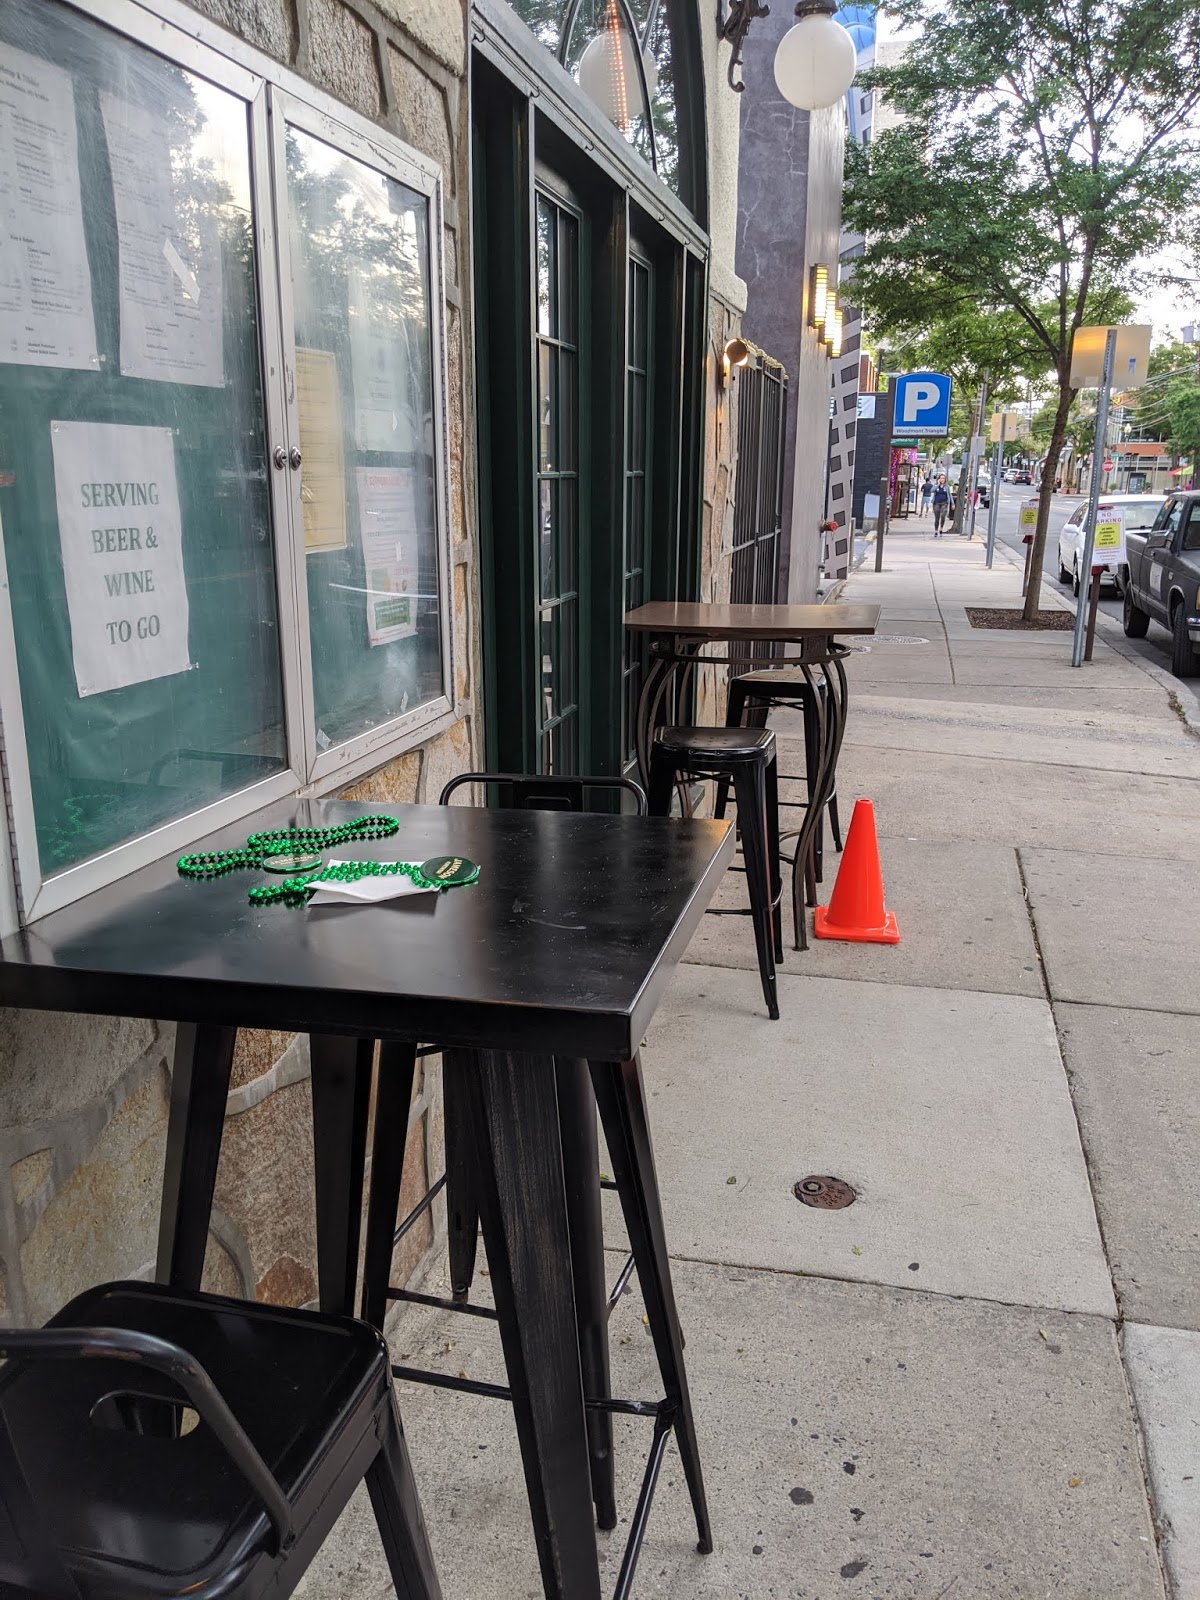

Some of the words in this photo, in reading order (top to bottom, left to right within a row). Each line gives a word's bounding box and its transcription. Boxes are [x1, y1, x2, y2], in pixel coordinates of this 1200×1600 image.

[903, 381, 941, 422] P
[924, 427, 944, 435] Triangle
[81, 482, 159, 508] SERVING
[91, 527, 142, 554] BEER
[145, 525, 159, 549] &
[104, 569, 155, 597] WINE
[106, 620, 132, 645] TO
[137, 614, 161, 640] GO
